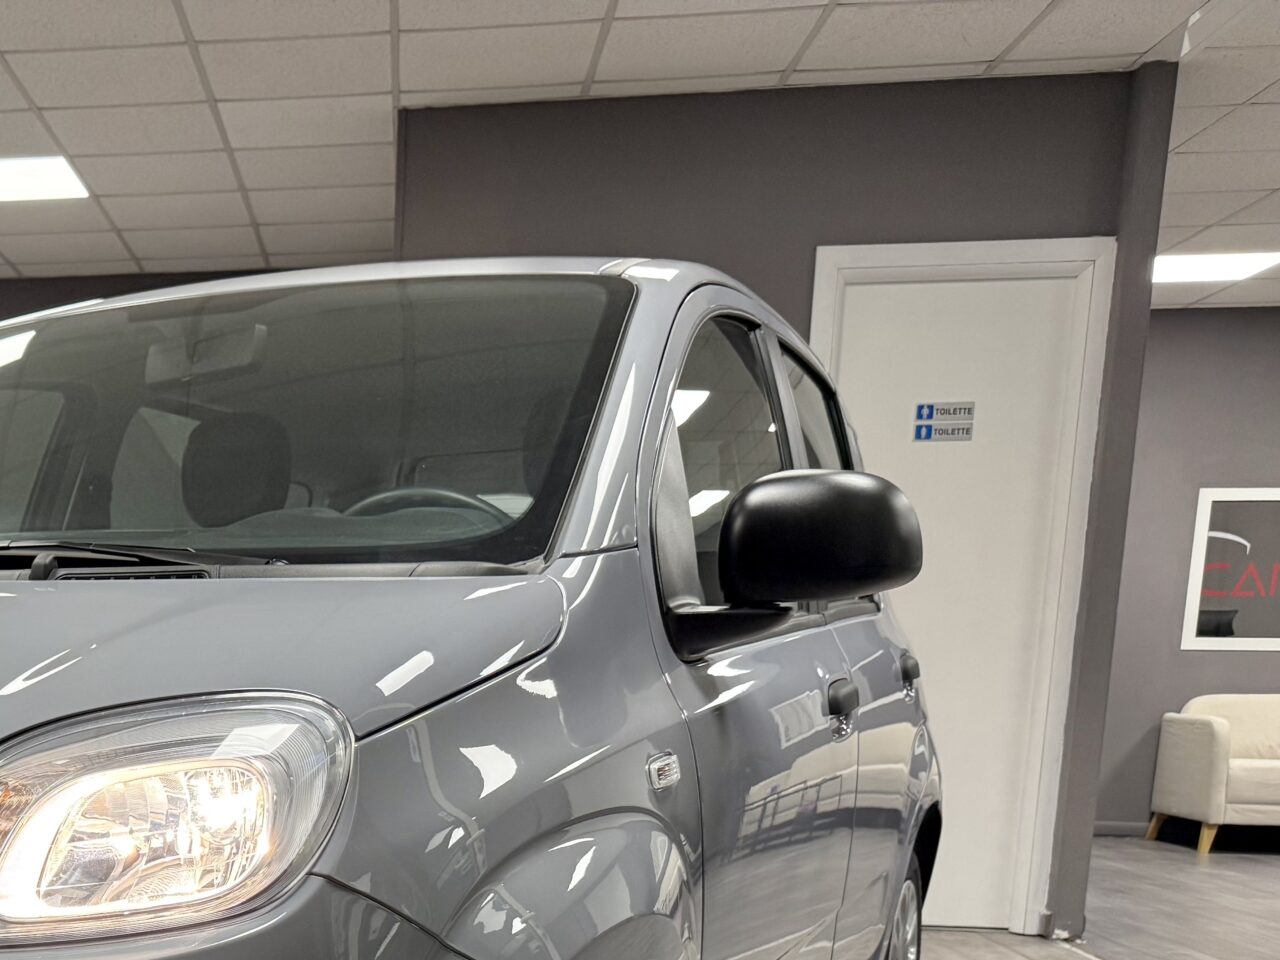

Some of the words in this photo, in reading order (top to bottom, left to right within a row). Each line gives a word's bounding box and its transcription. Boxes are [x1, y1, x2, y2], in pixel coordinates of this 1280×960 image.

[935, 407, 973, 416] TOILETTE
[933, 427, 971, 436] TOILETTE
[1201, 562, 1280, 598] CA
